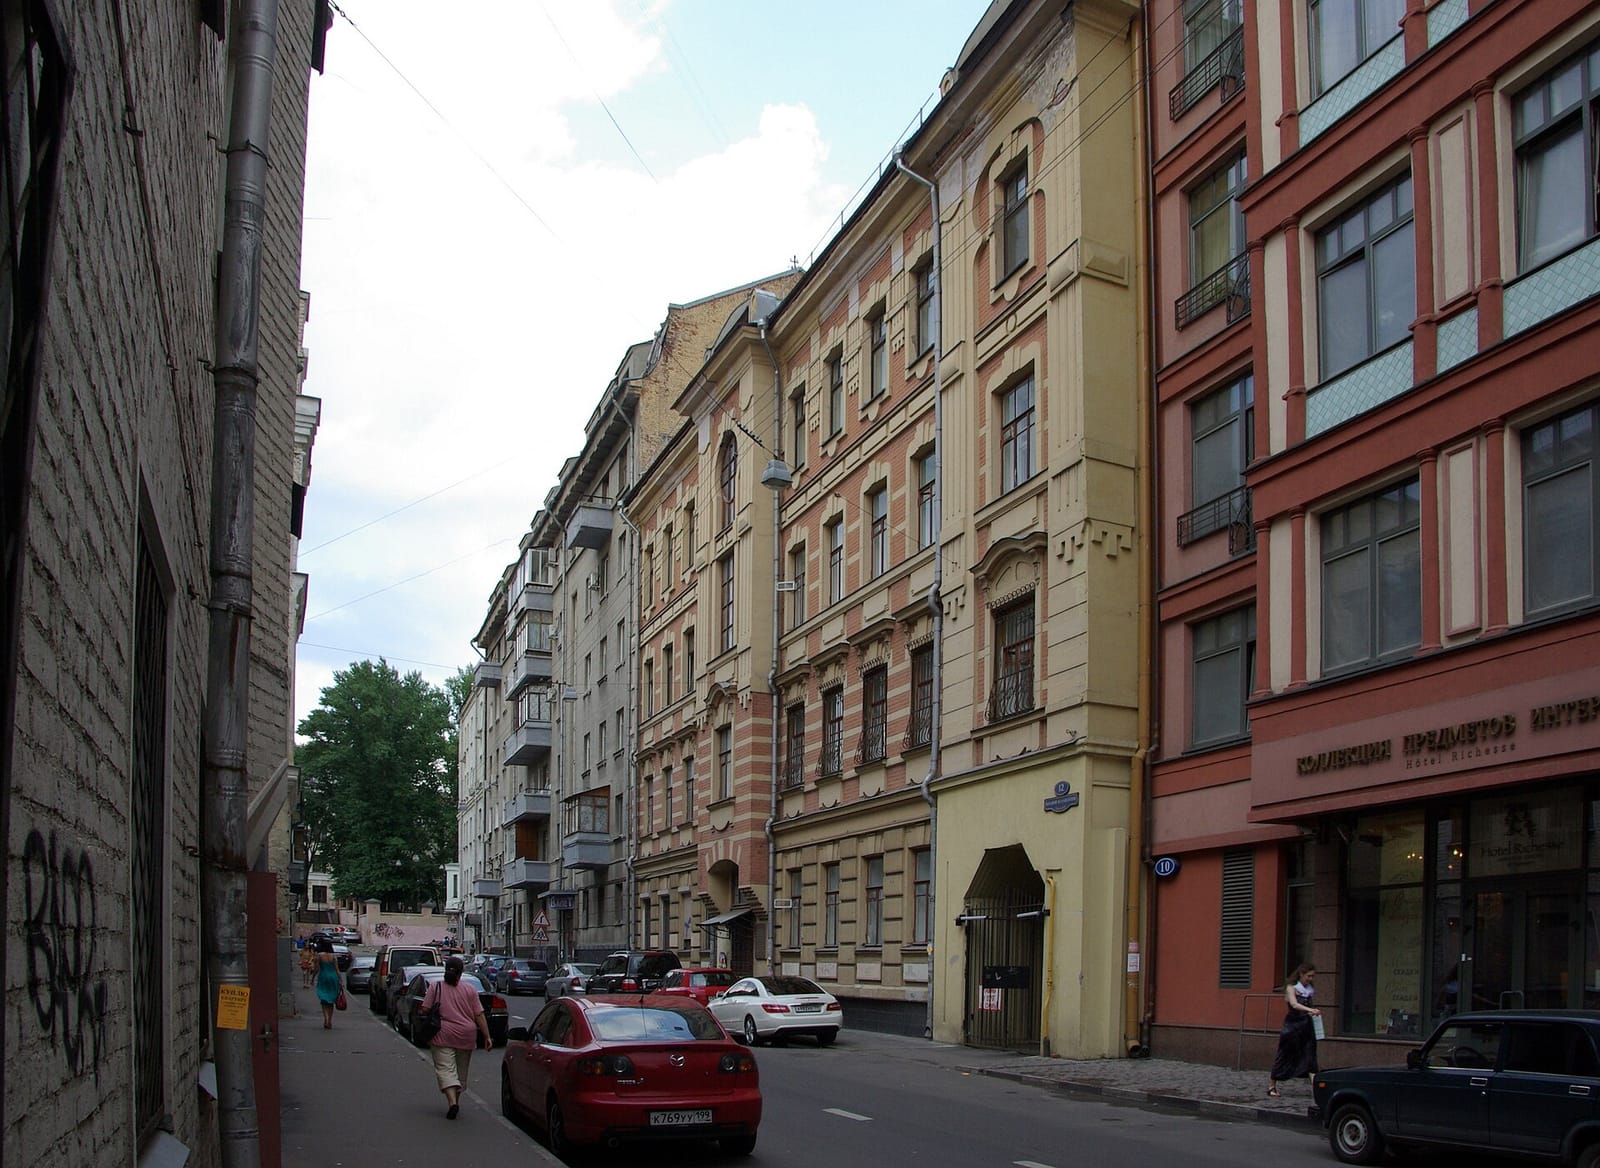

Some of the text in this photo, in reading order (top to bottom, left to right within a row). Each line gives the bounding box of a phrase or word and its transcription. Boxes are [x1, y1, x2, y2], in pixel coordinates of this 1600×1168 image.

[1296, 738, 1392, 775] КОЛЛЕКЦИЯ
[1403, 712, 1517, 756] ПРЕДМЕТОВ
[1058, 783, 1065, 792] 12
[1160, 861, 1170, 873] 10
[695, 1111, 710, 1119] 199
